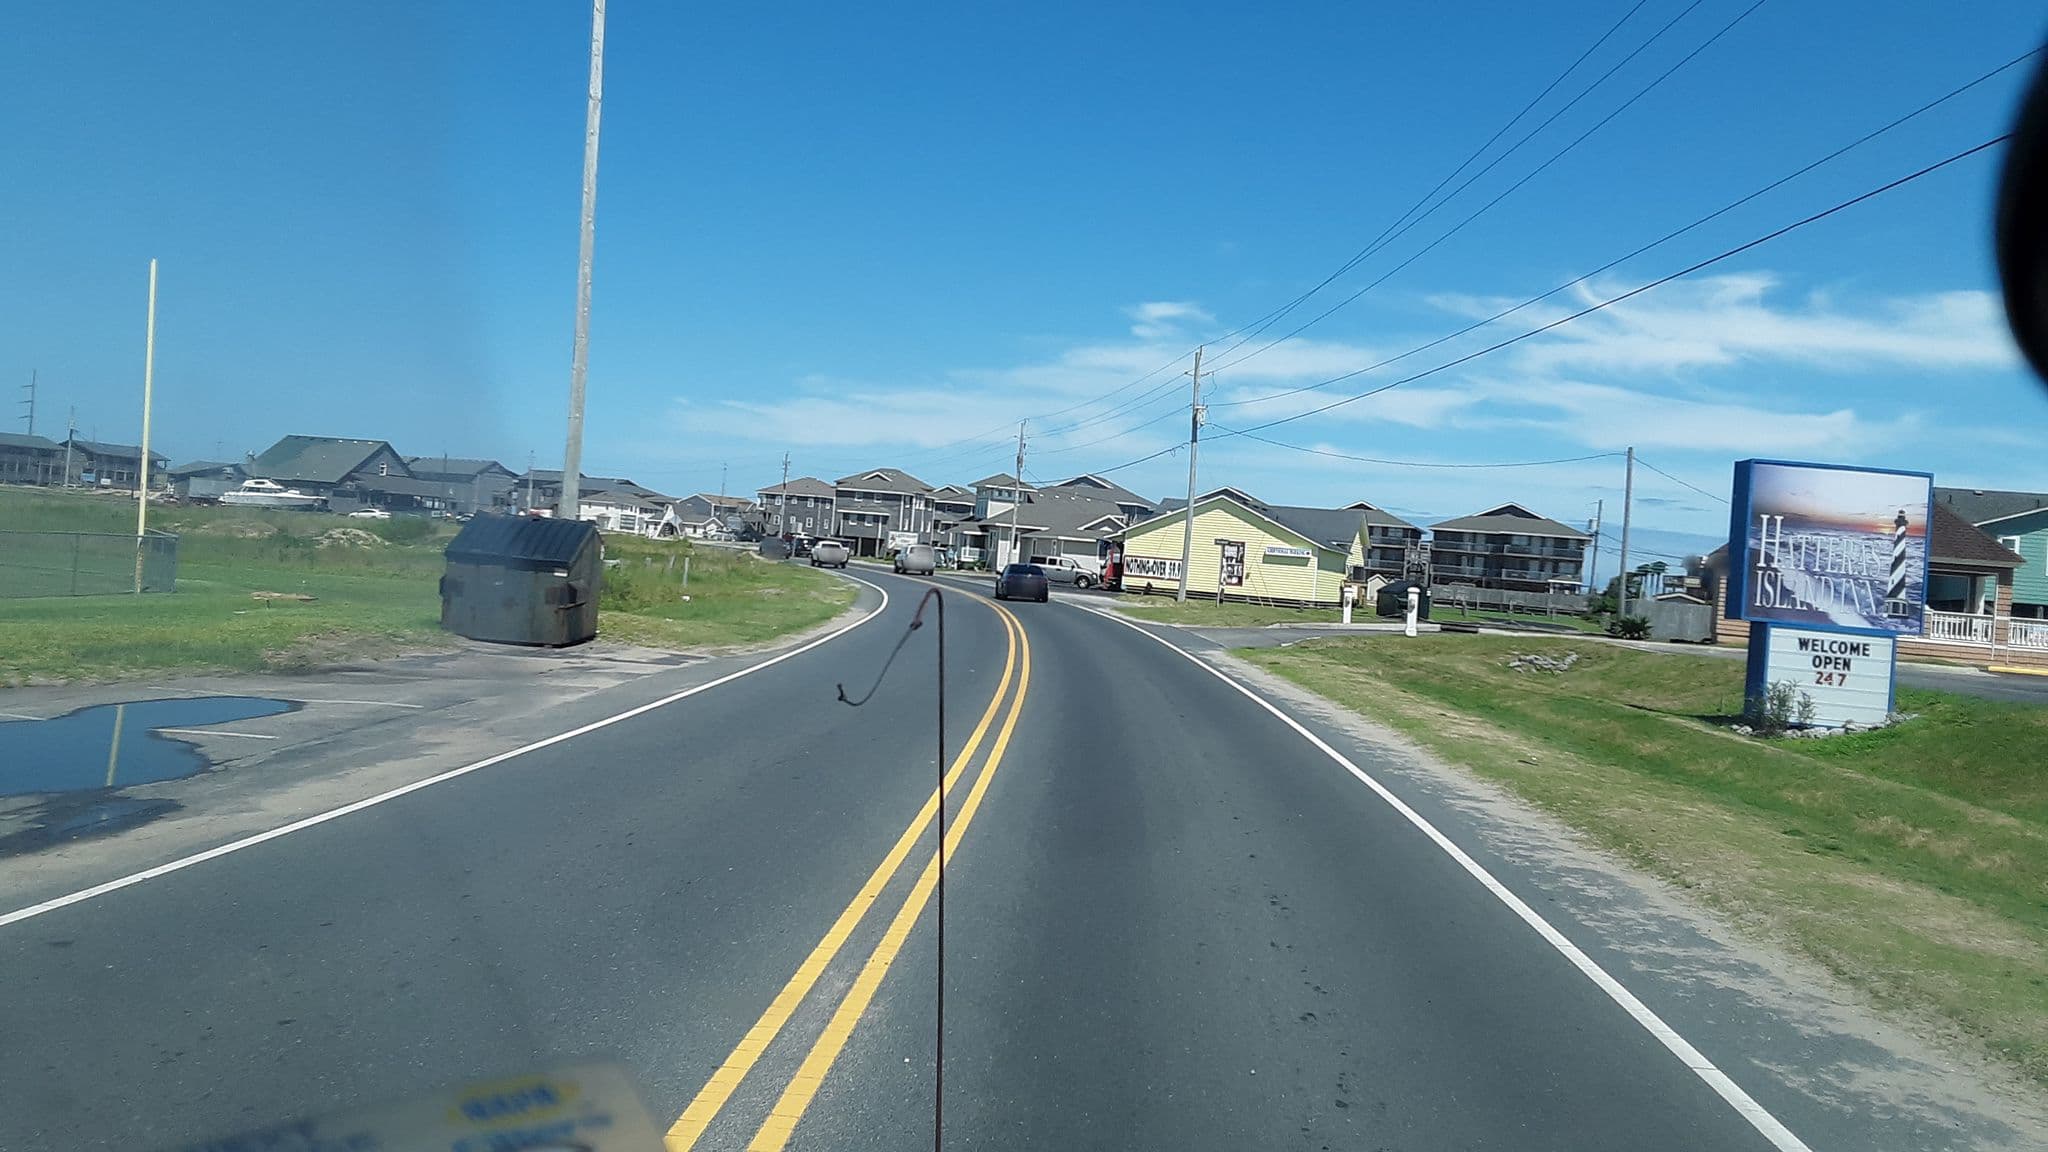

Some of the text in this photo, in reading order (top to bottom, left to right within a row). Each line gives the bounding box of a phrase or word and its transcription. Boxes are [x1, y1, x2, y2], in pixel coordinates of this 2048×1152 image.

[1756, 514, 1881, 577] HATTERAS
[1754, 569, 1880, 615] ISLAND INN
[1798, 637, 1871, 657] WELCOME
[1812, 655, 1851, 672] OPEN
